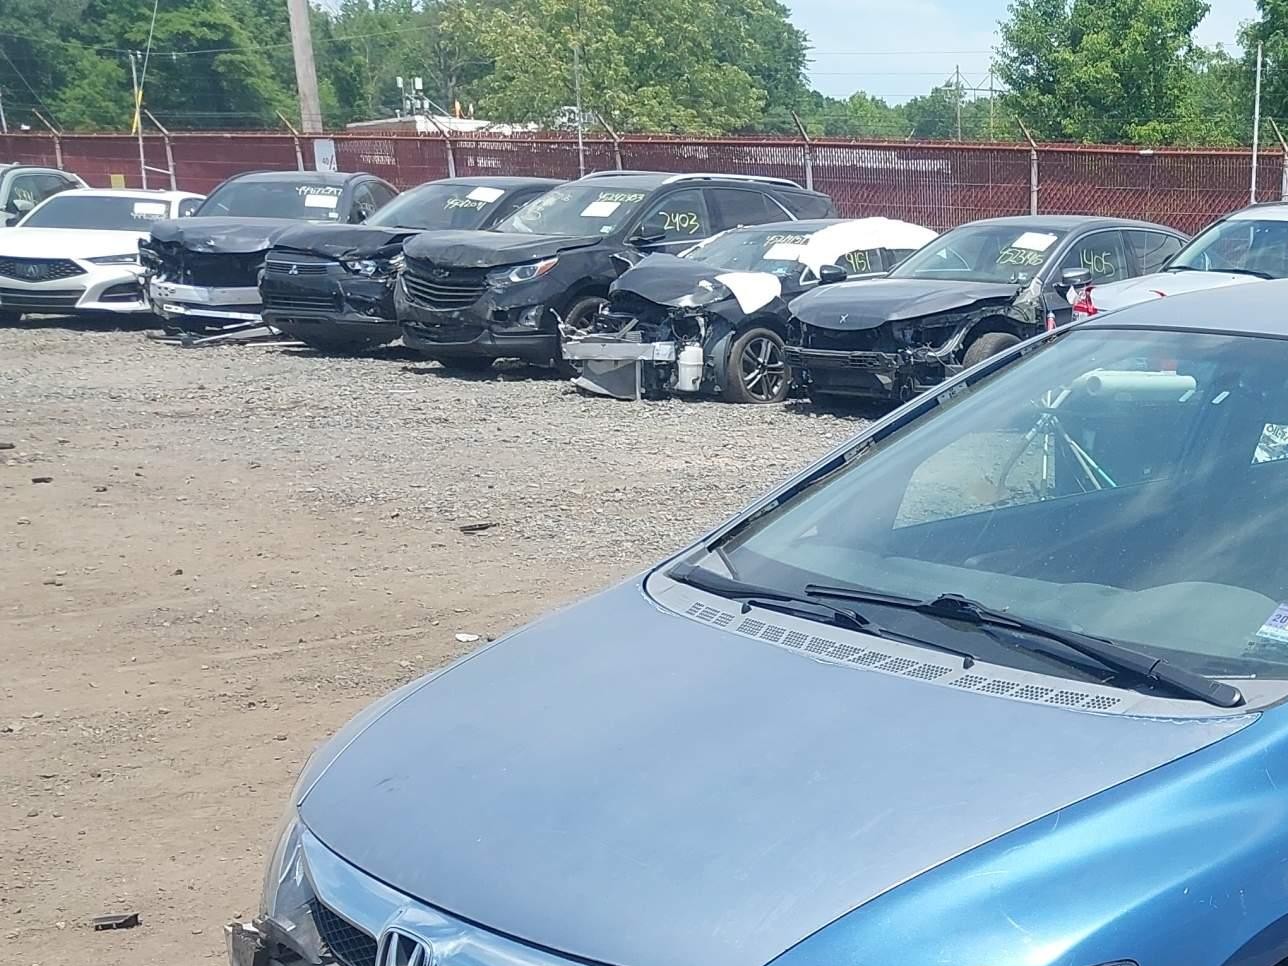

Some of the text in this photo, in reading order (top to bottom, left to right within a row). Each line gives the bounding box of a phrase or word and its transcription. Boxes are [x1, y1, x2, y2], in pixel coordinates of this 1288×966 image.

[659, 211, 700, 234] 2403
[845, 252, 872, 273] 9151
[1079, 248, 1115, 278] 1405
